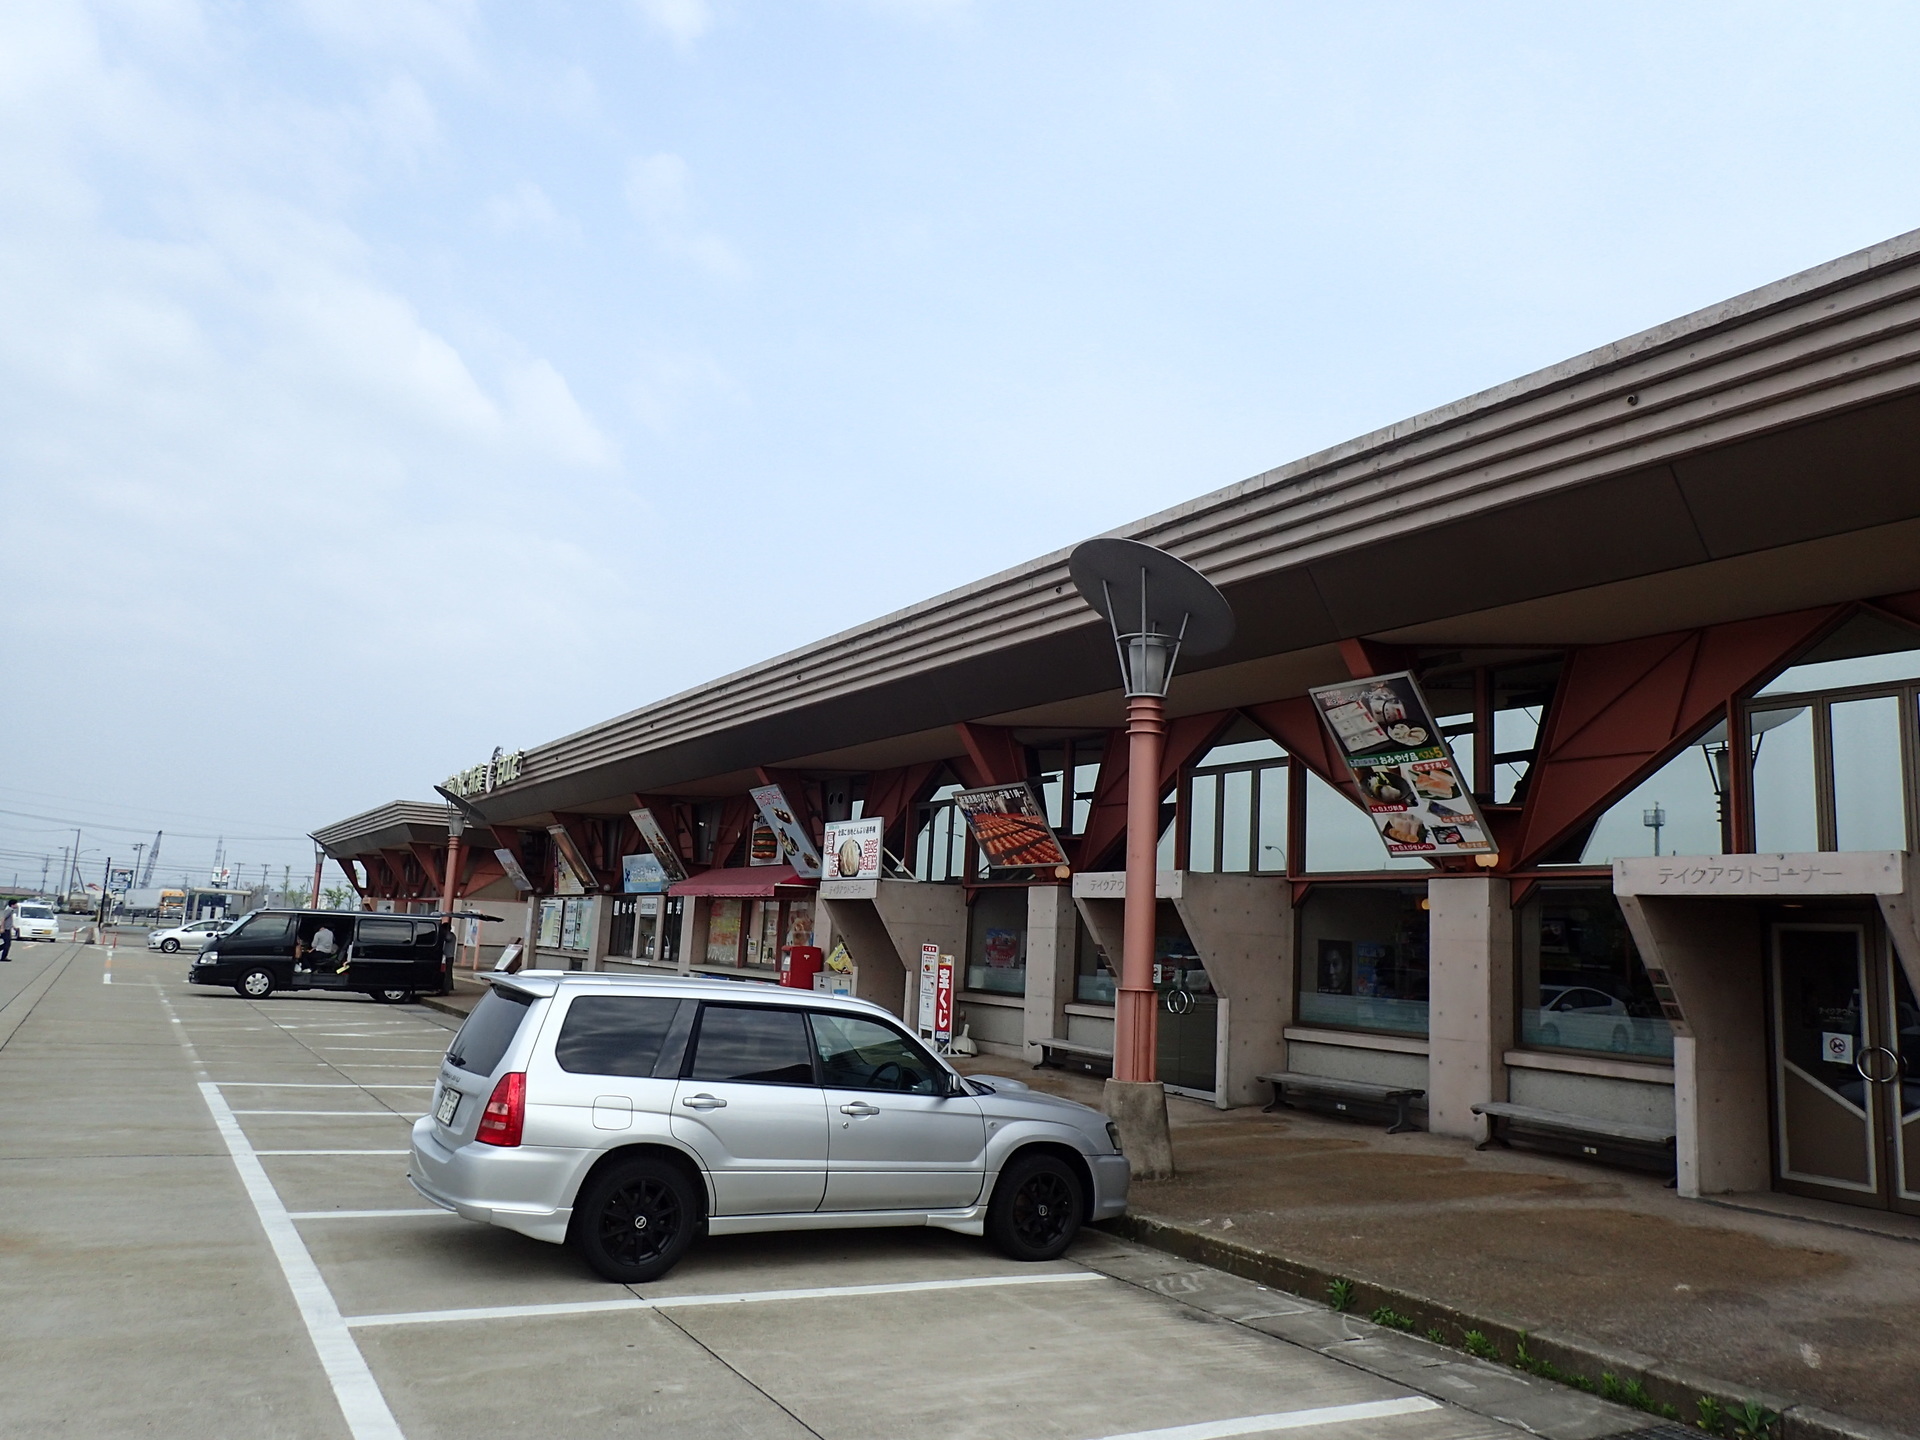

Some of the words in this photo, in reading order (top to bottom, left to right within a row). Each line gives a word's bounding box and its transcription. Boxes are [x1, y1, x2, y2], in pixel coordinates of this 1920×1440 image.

[1658, 865, 1842, 885] テイクアウトコーナー
[938, 968, 950, 1028] 宝くじ
